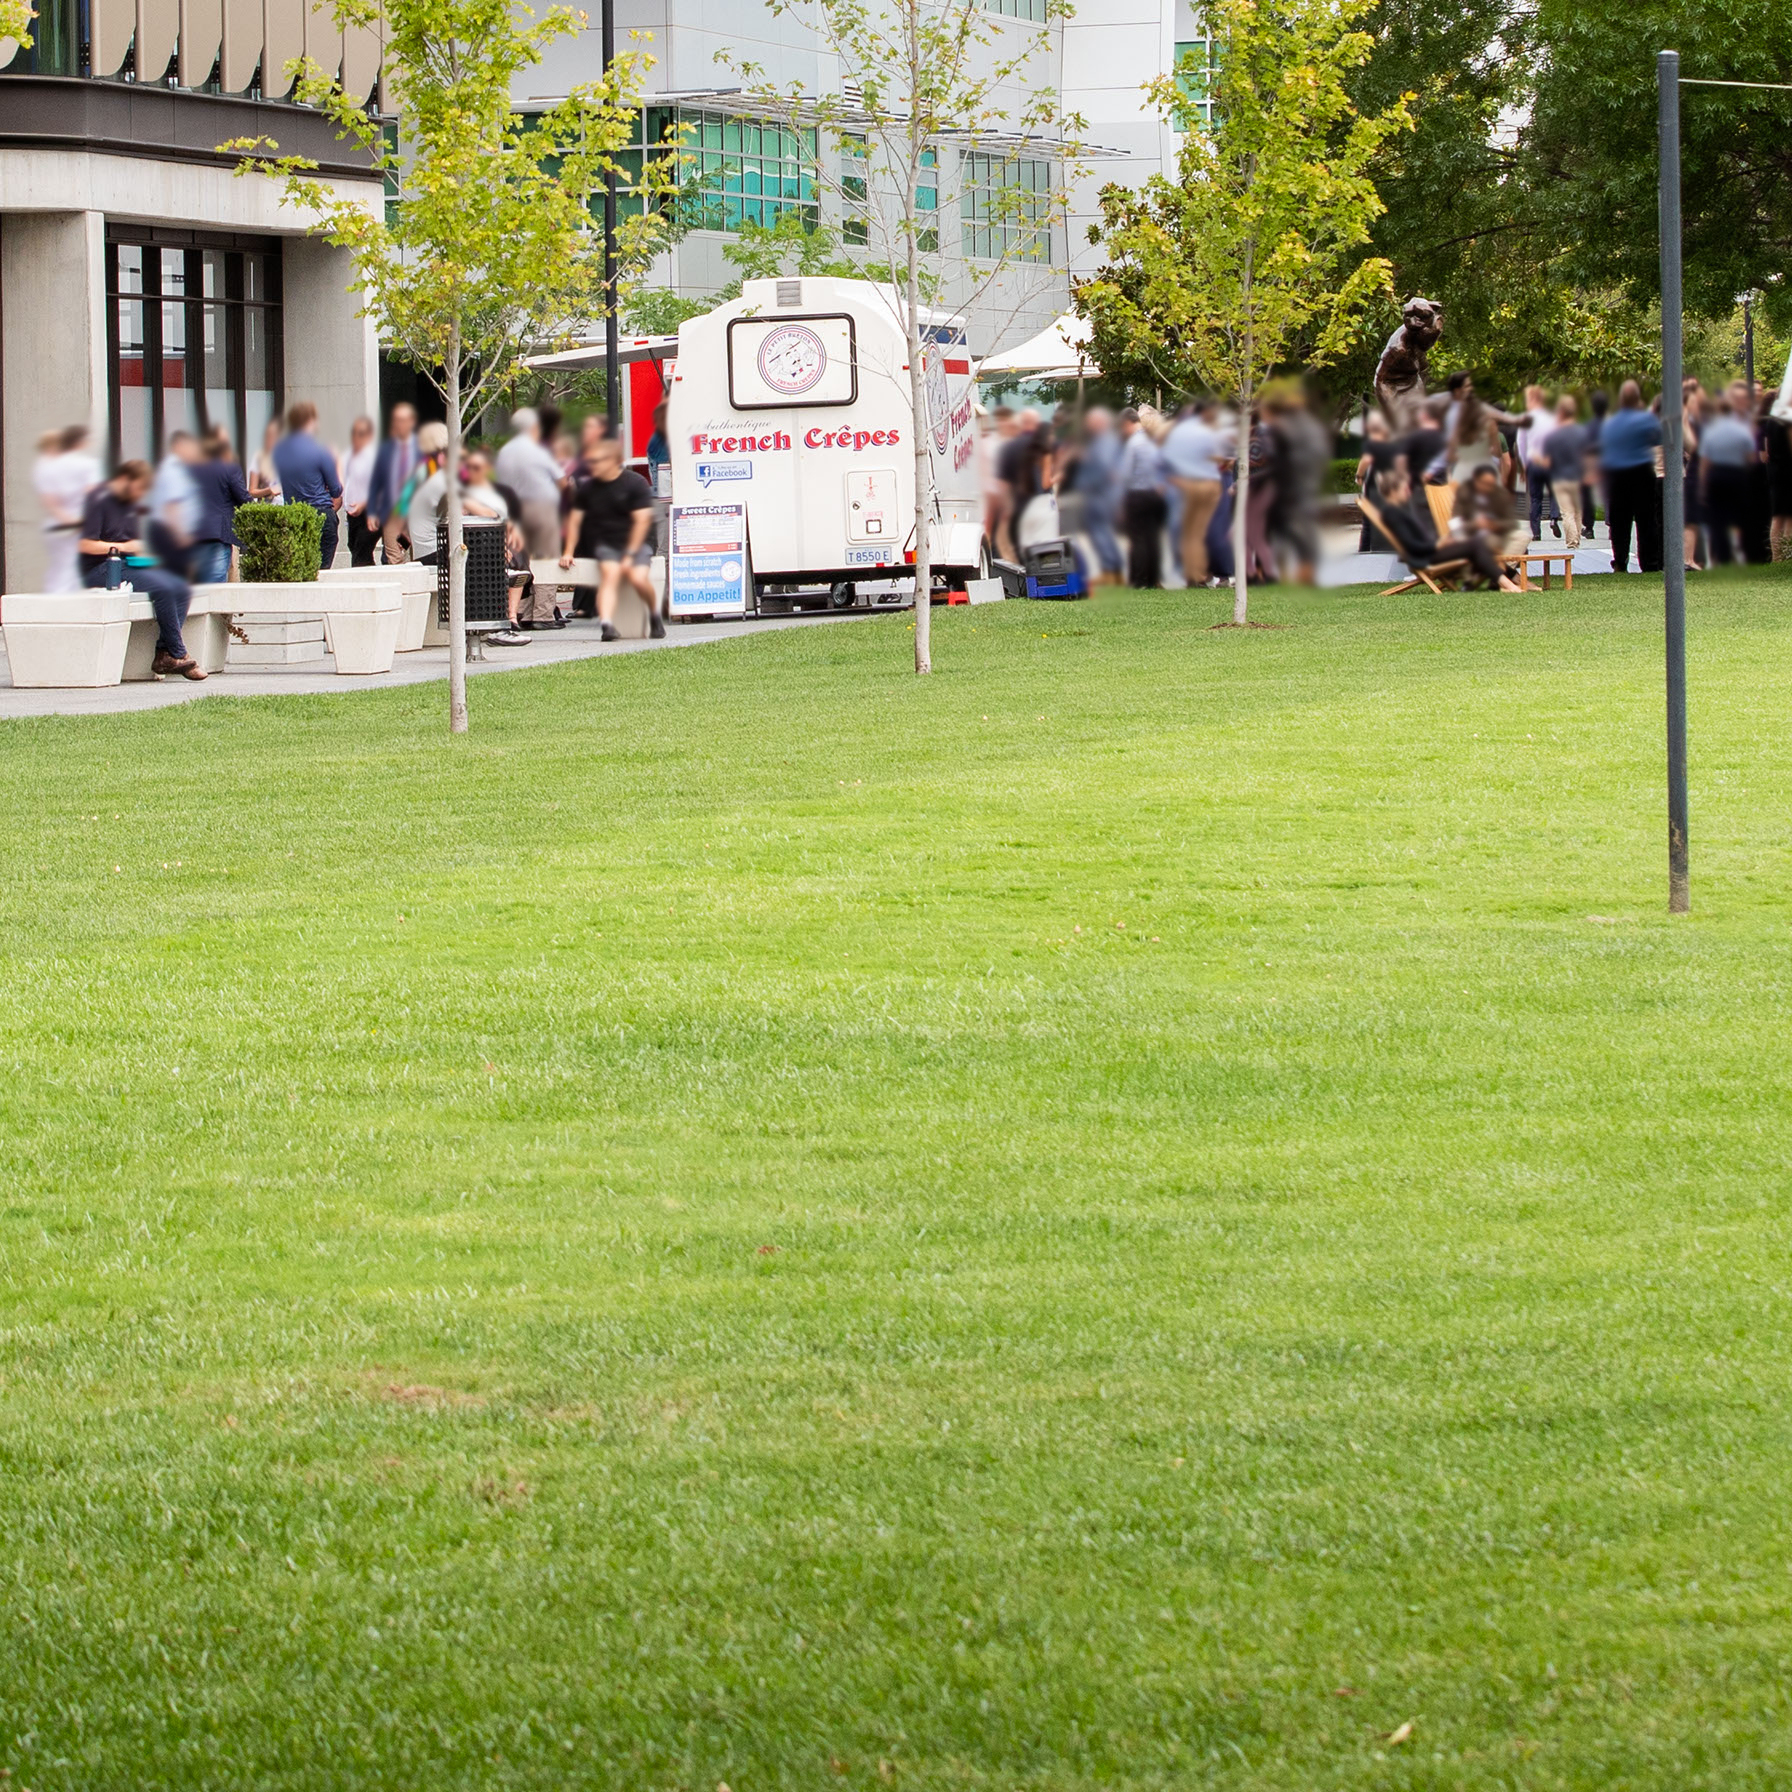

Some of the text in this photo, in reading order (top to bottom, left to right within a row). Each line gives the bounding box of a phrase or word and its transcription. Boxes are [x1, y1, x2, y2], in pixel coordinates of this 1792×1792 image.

[691, 424, 901, 455] French Crêpes
[712, 468, 748, 477] Facebook
[681, 507, 707, 515] Sweet
[848, 550, 889, 562] T 8550 E
[674, 588, 741, 603] Bon Appetit!
